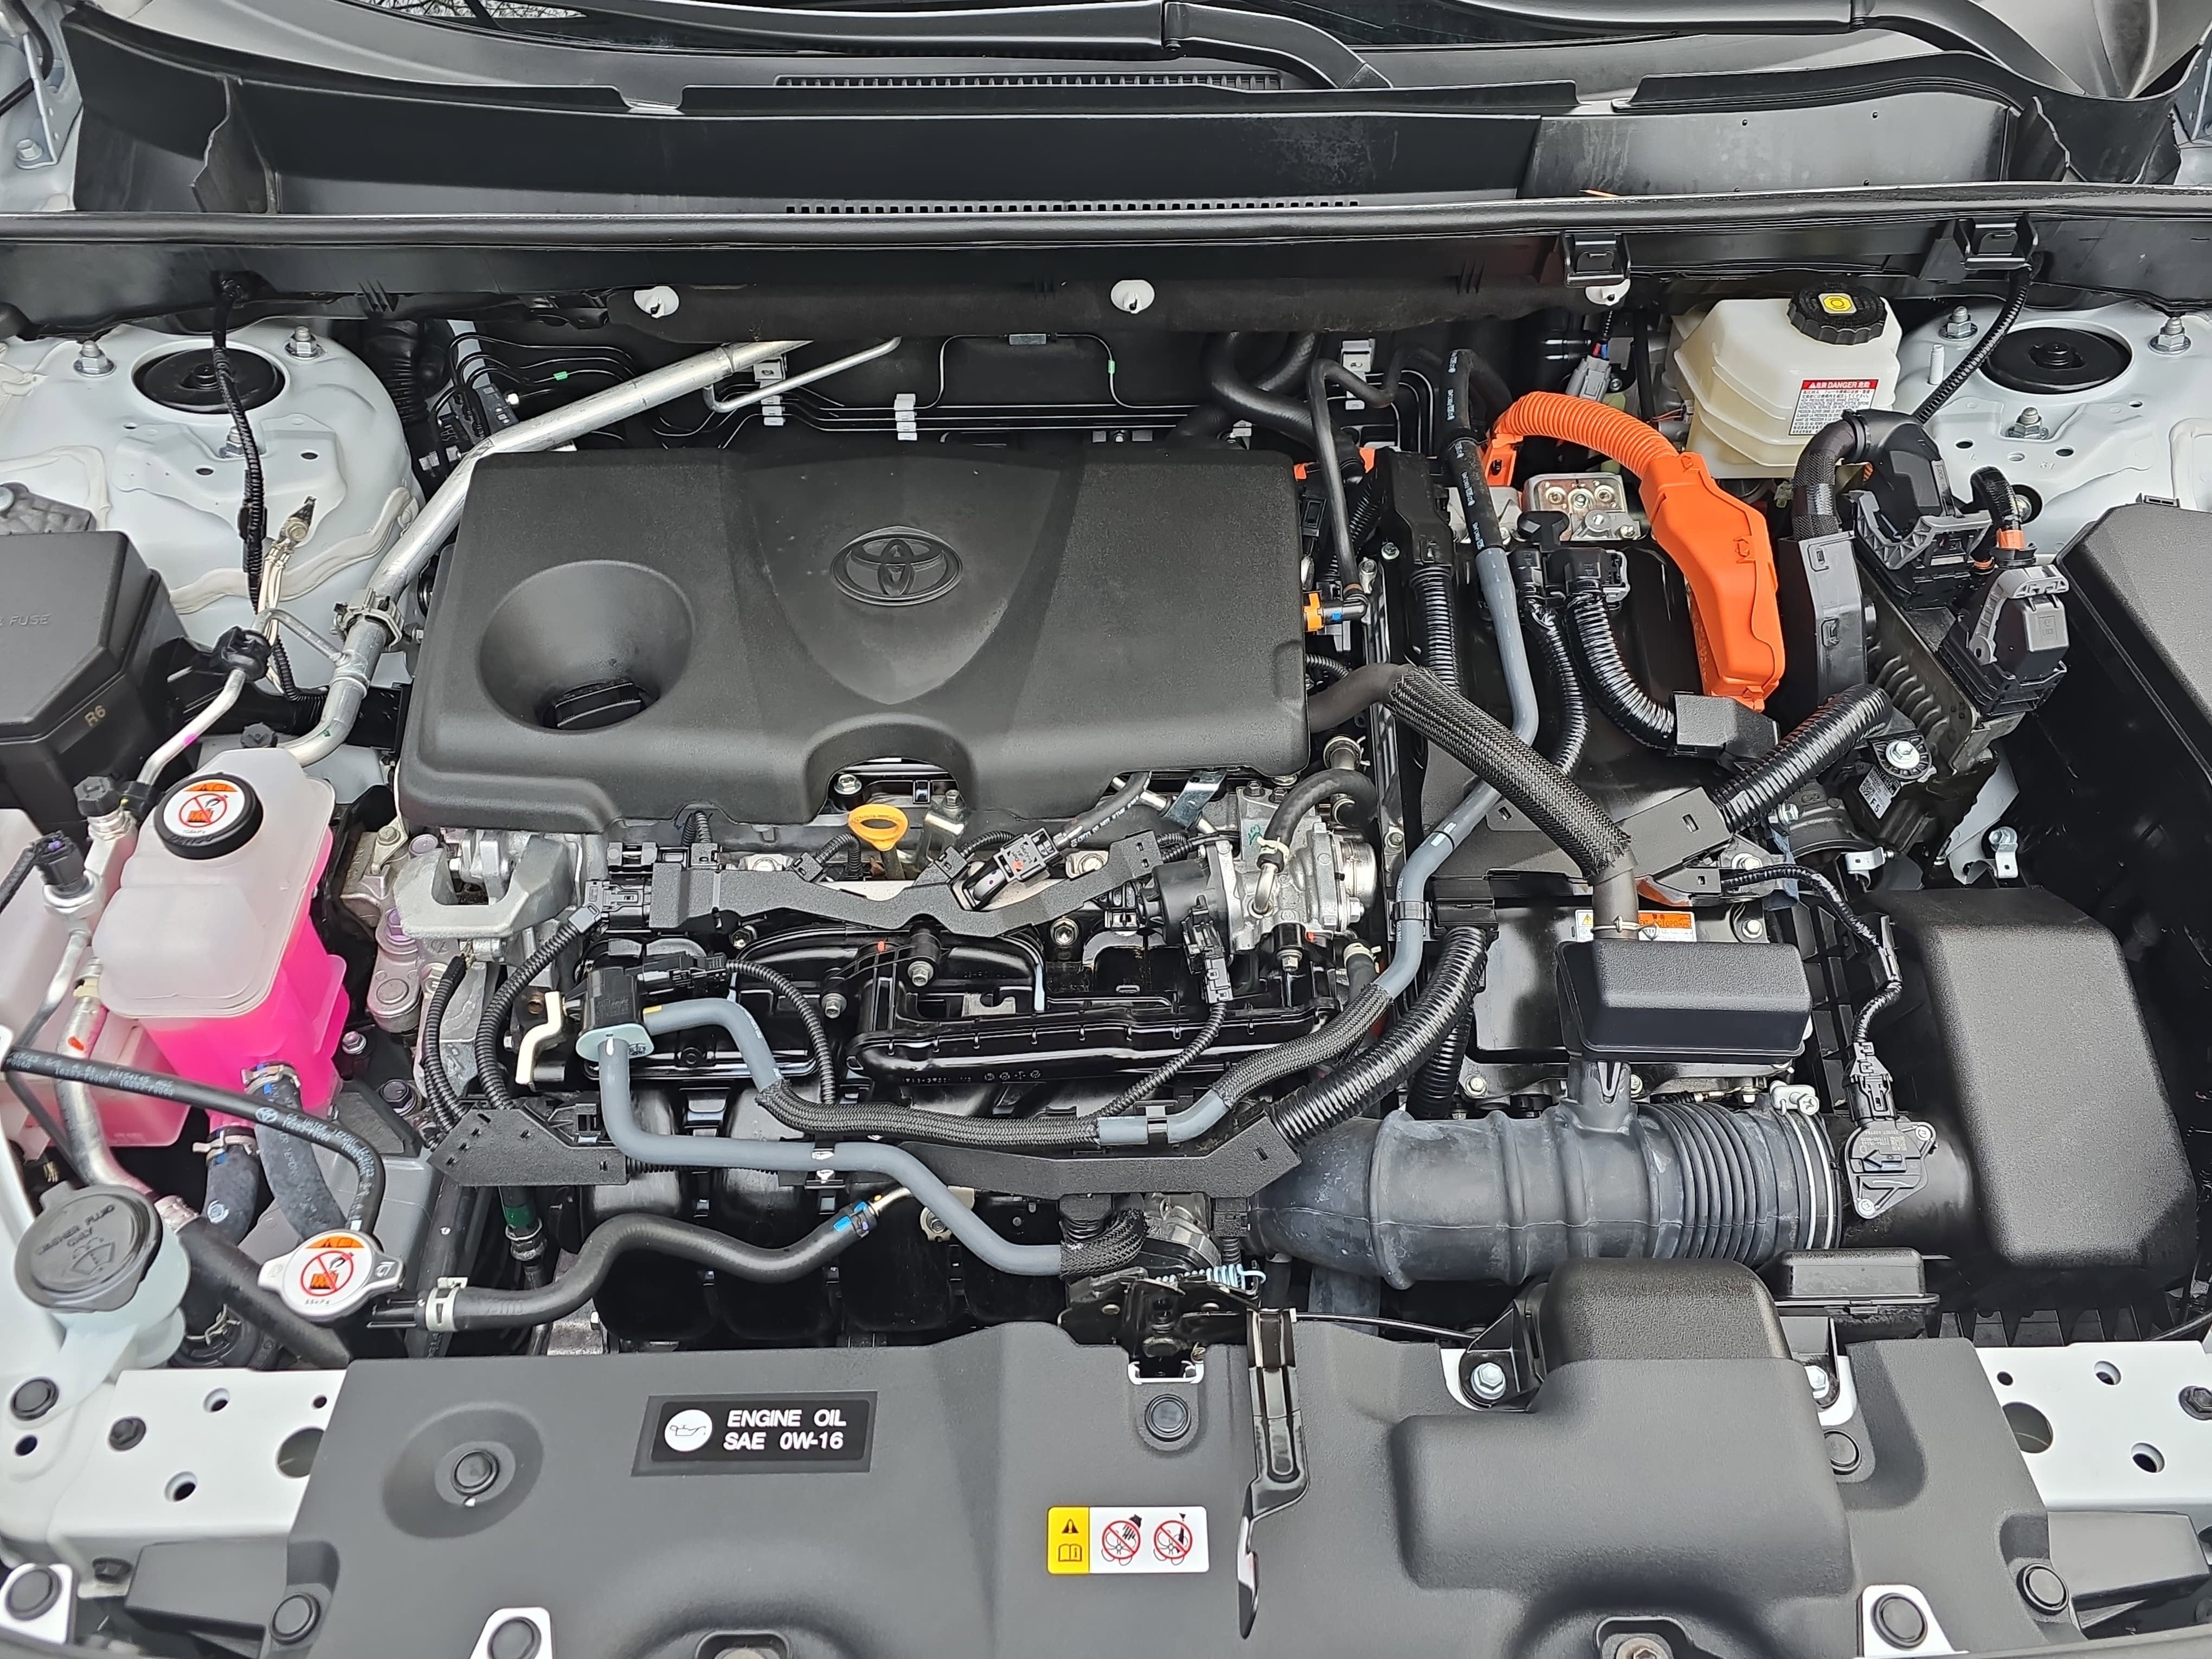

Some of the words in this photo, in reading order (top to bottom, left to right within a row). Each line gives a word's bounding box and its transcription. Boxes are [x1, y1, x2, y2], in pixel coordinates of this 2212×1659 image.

[9, 613, 51, 626] FUSE
[84, 705, 106, 727] R6
[727, 1409, 802, 1427] ENGINE
[814, 1409, 847, 1427] OIL
[723, 1432, 766, 1450] SAE
[780, 1431, 844, 1450] 0W-16
